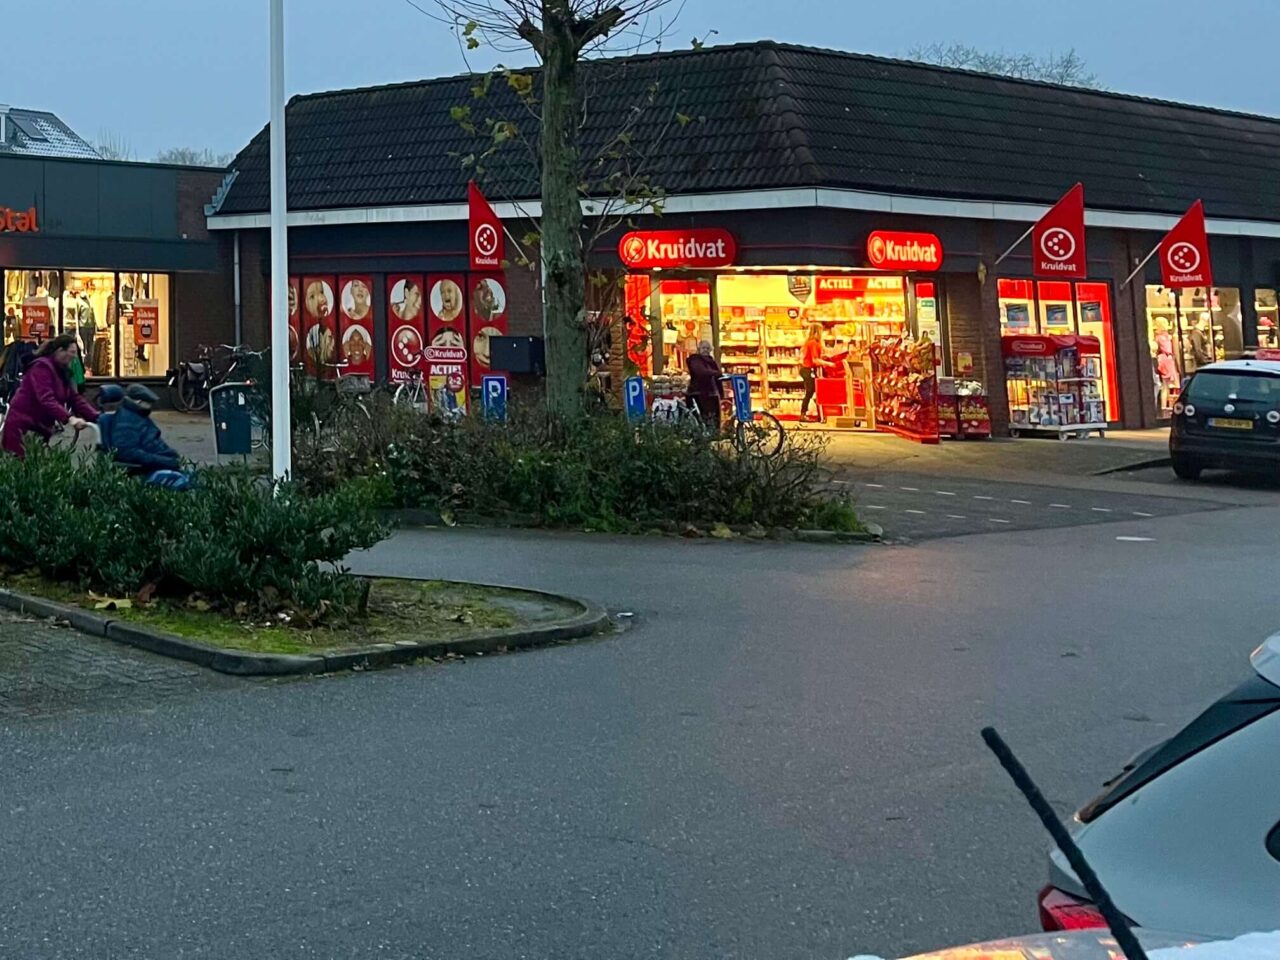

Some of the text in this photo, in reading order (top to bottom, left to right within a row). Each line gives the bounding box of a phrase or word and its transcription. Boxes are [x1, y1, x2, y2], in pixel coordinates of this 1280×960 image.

[647, 238, 726, 259] Kruidvat
[886, 240, 937, 262] Kruidvat
[1041, 261, 1077, 272] Kruidvat
[819, 279, 853, 289] ACTIE!
[1170, 274, 1203, 282] Kruidvat
[434, 348, 464, 358] Kruidvat
[488, 381, 501, 401] P
[628, 381, 640, 406] P
[737, 379, 746, 402] P
